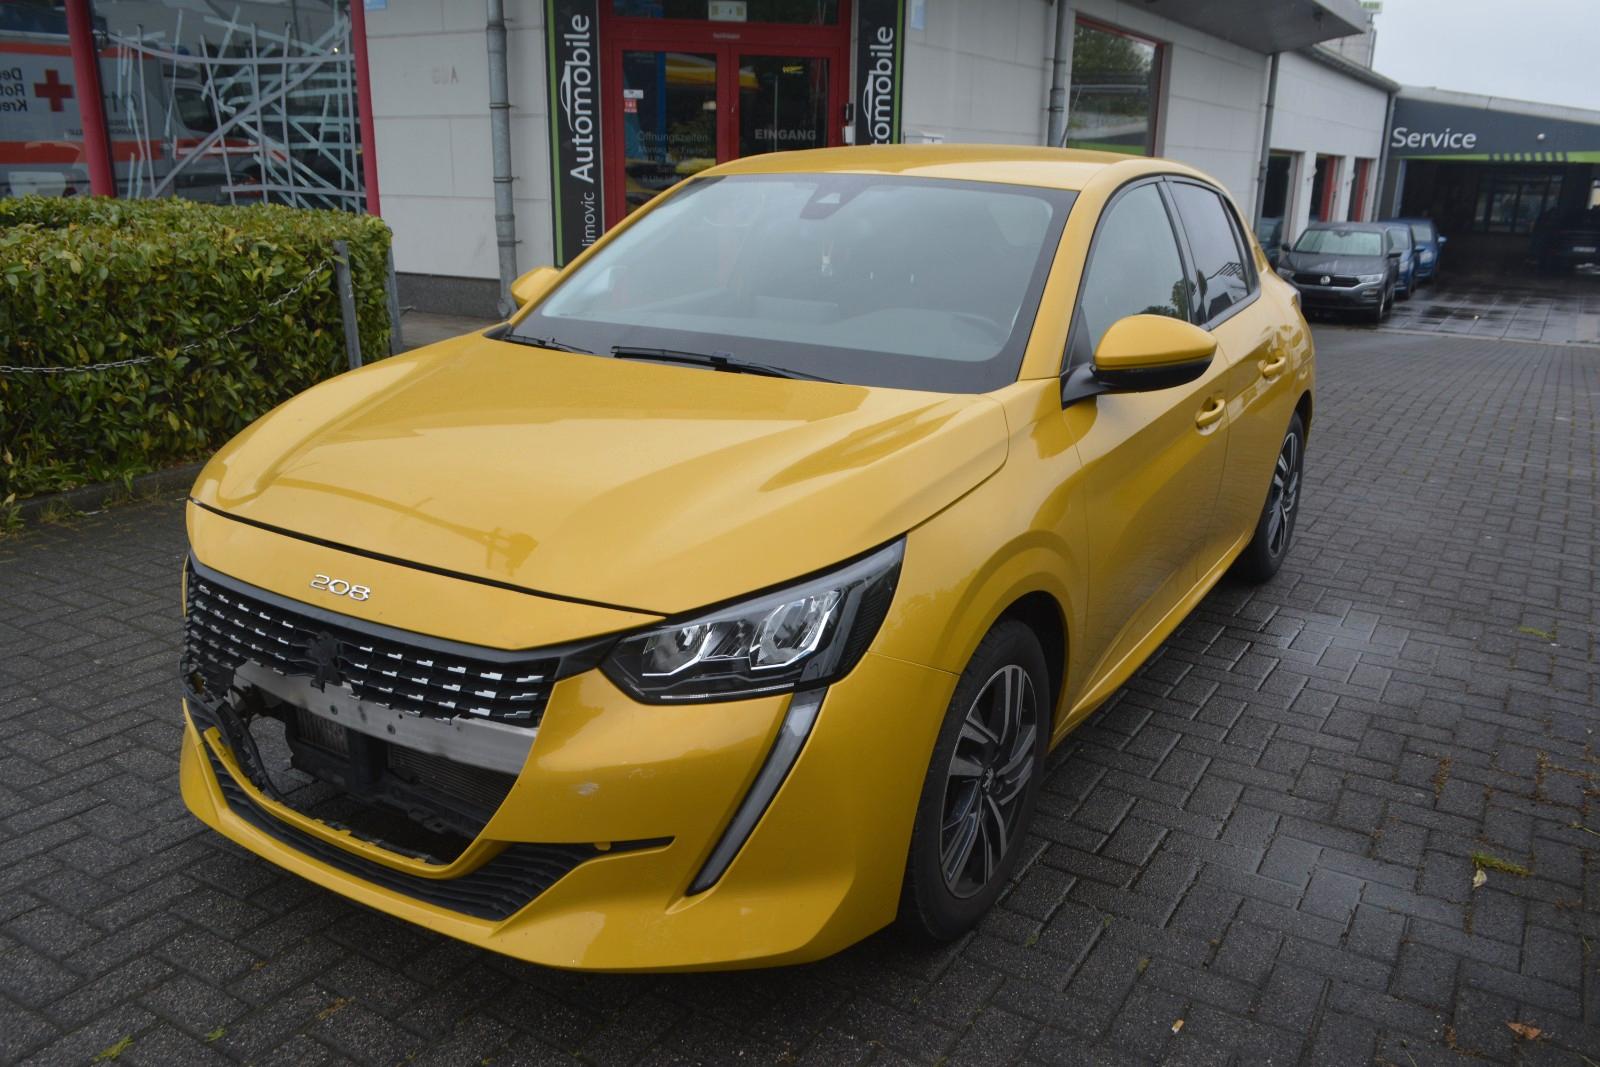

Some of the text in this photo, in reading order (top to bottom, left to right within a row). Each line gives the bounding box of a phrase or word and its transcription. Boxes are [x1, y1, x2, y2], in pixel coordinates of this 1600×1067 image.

[564, 14, 594, 184] Automobile
[754, 128, 817, 141] EINGANG
[1391, 126, 1477, 149] Service
[310, 573, 372, 602] 208
